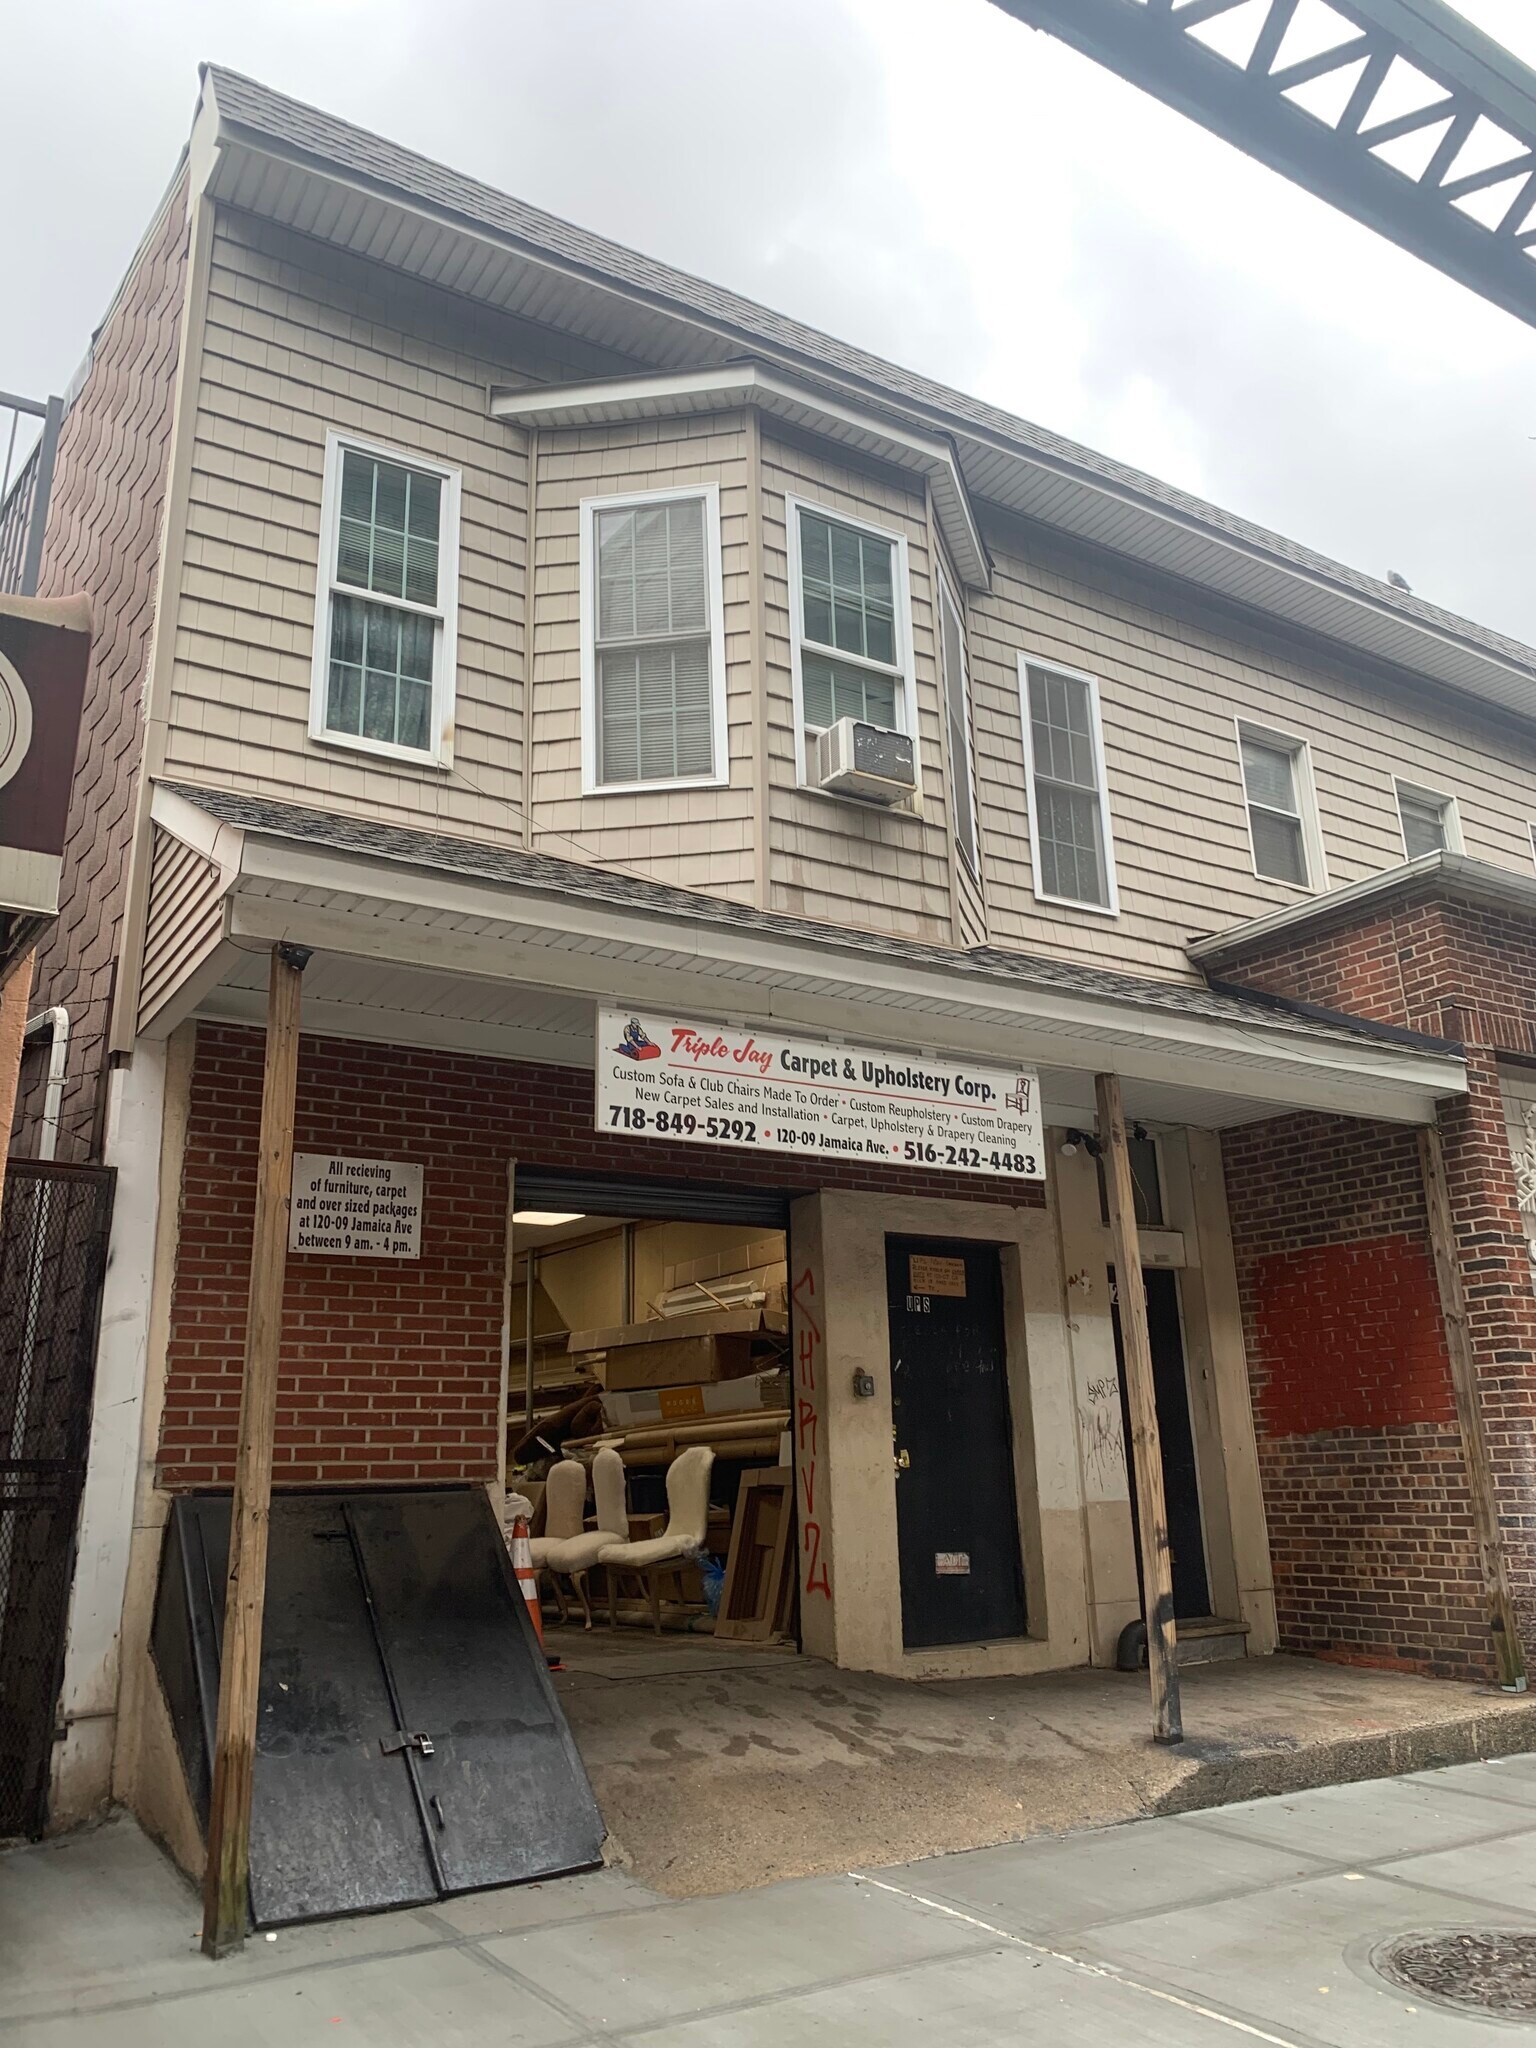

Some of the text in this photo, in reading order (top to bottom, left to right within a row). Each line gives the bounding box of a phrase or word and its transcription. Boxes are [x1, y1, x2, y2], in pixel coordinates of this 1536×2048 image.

[671, 1028, 997, 1103] Triple Jay Carpet & Upholstery Corp.
[612, 1065, 1033, 1136] Custom Sofa & Club Chairs Made To Order Custom Reupholstery Custom Drapery
[635, 1087, 1017, 1149] New Carpet Sales and Installation Carpet, Upholstery & Drapery Cleaning
[609, 1105, 1037, 1174] 718-849-5292 120-09 Jamaica Ave. 516-242-4483
[329, 1161, 391, 1182] All recieving
[310, 1178, 407, 1200] of furniture, carpet
[296, 1196, 418, 1219] and over sized packages
[299, 1214, 413, 1235] at 120-09 Jamaica Ave
[298, 1232, 342, 1249] between
[345, 1235, 351, 1249] 9
[354, 1238, 373, 1251] am.
[383, 1237, 390, 1251] 4
[392, 1240, 411, 1254] pm.
[906, 1295, 930, 1313] UPS
